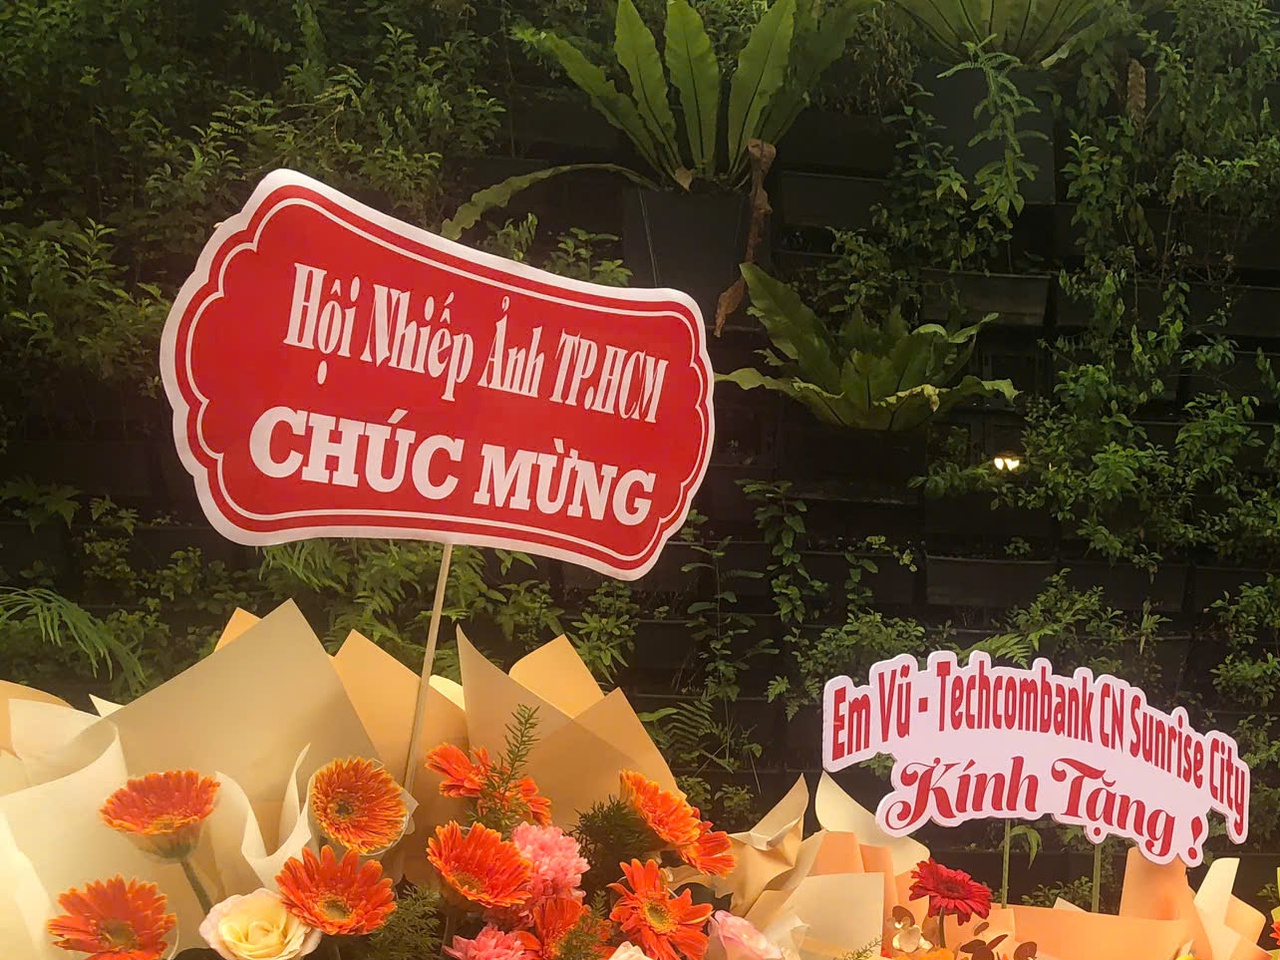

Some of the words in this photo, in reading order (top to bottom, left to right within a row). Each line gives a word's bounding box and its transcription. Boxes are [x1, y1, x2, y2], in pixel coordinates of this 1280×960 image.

[283, 262, 359, 385] Hội
[360, 283, 474, 402] Nhiếp
[478, 295, 544, 398] Ảnh
[551, 330, 669, 423] TP.HCM
[249, 405, 465, 500] CHÚC
[473, 439, 657, 526] MỪNG
[831, 686, 871, 762] Em
[877, 664, 913, 743] Vũ
[918, 697, 928, 713] -
[936, 660, 1094, 743] Techcombank
[1099, 682, 1125, 752] CN
[1129, 689, 1203, 789] Sunrise
[1208, 736, 1248, 838] City
[885, 755, 1040, 830] Kính
[1050, 757, 1176, 857] Tặng
